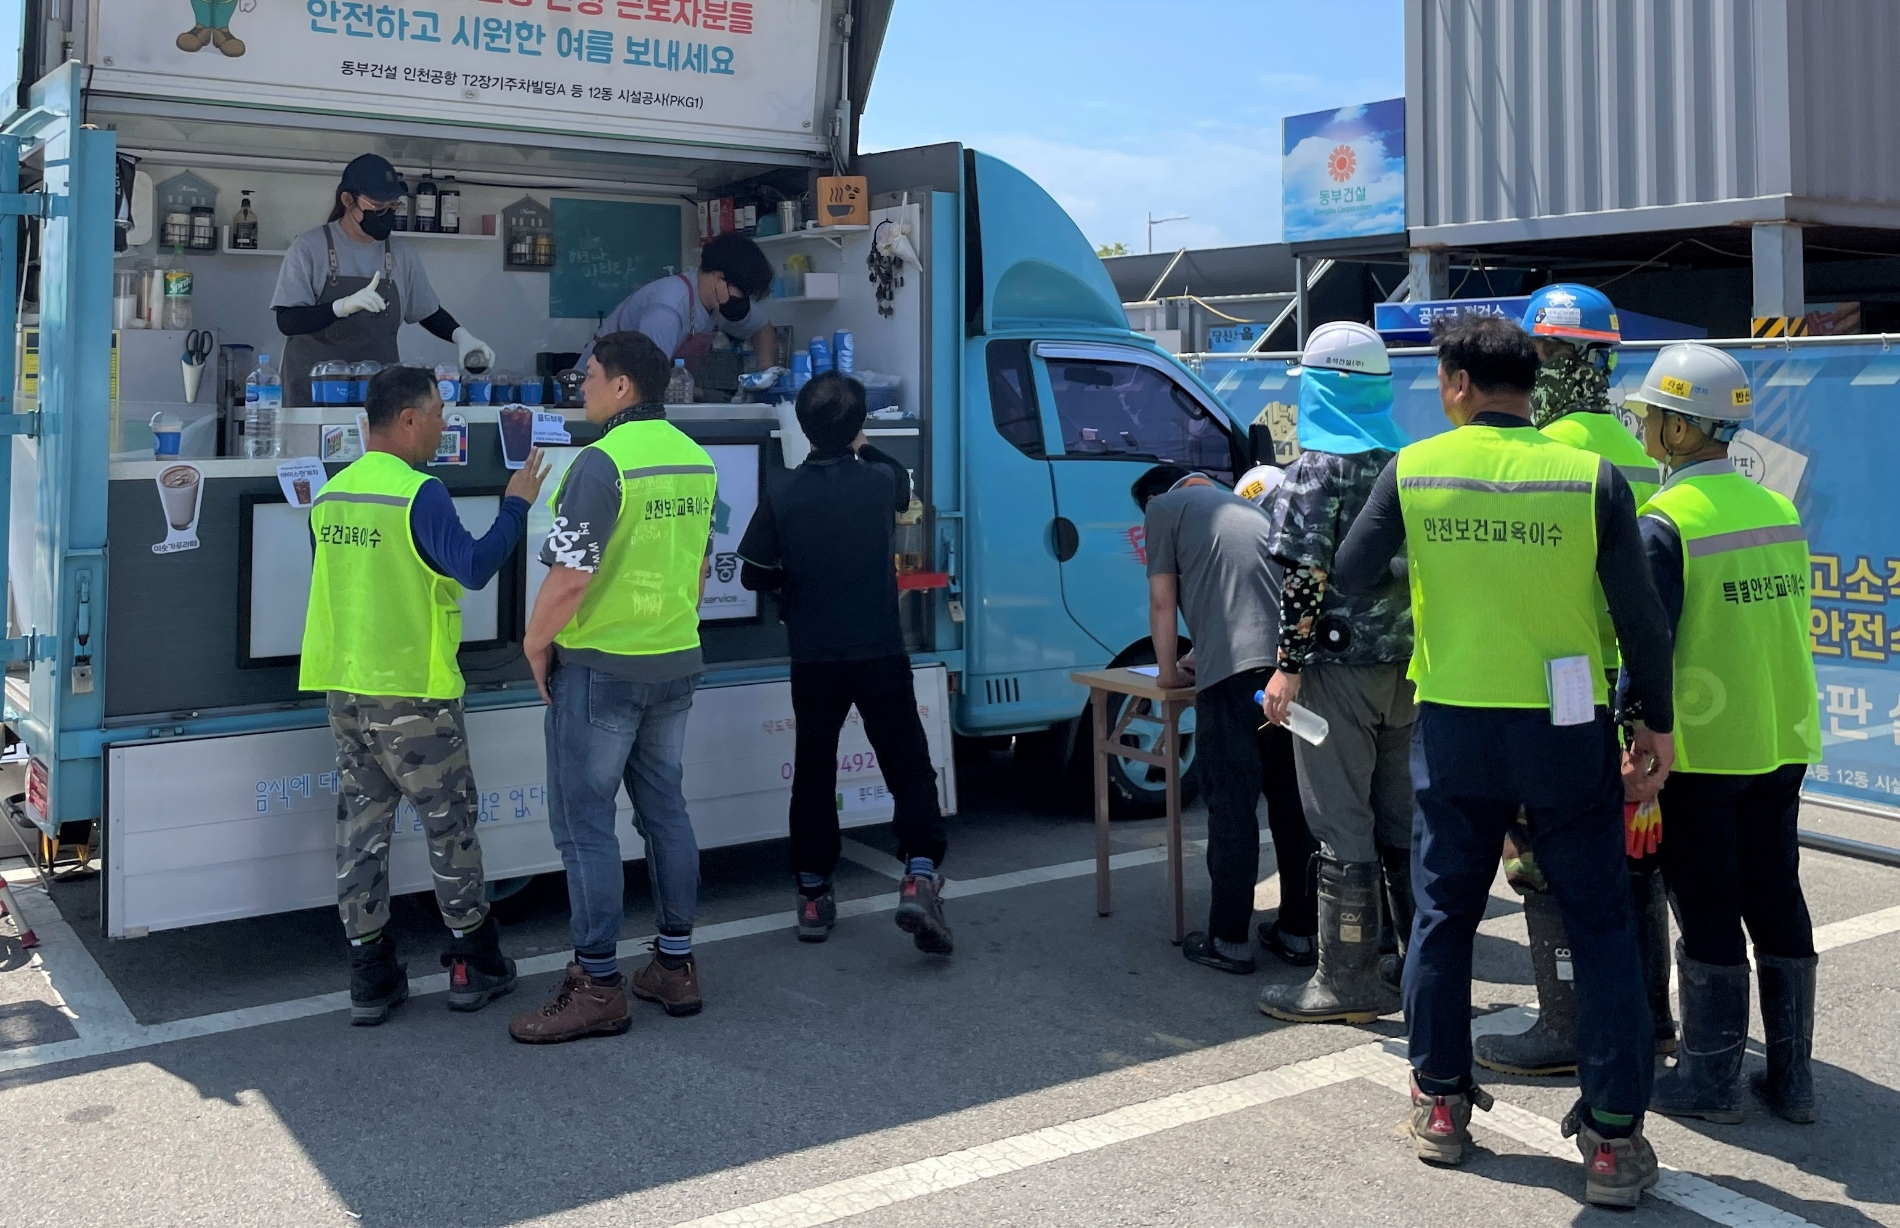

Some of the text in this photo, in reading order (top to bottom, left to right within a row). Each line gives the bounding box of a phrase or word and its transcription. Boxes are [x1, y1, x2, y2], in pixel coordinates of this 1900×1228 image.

[306, 0, 735, 75] 안전하고 시원한 여름 보내세요
[340, 60, 704, 110] 동부건설 인천공항 T2장기주차빌딩A 등 12동 시설공사(PKG1)
[1313, 203, 1372, 216] Dongbu Corporation
[1319, 185, 1366, 206] 동부건설
[1424, 517, 1563, 547] 안전보건교육이수
[703, 593, 738, 604] service
[1723, 573, 1806, 605] 특별안전교육이수
[1817, 684, 1873, 740] 판
[858, 784, 895, 803] 푸디트
[1836, 768, 1869, 789] 12동
[255, 773, 311, 813] 음식에
[509, 784, 547, 819] 없다
